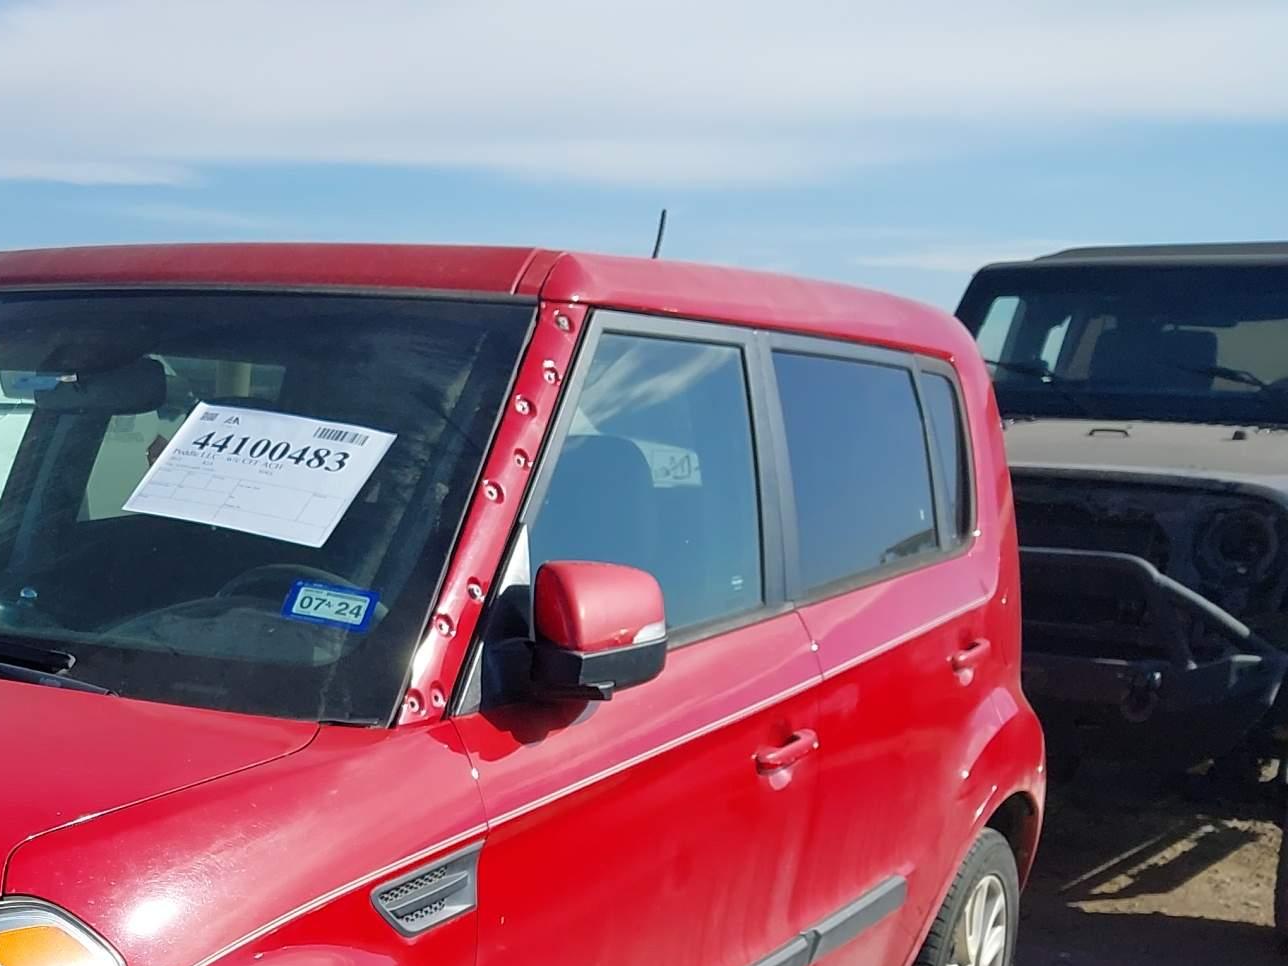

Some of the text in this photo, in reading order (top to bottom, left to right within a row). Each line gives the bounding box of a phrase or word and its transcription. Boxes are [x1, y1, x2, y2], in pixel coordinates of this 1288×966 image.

[191, 431, 351, 473] 44100483
[299, 596, 363, 619] 07 24
